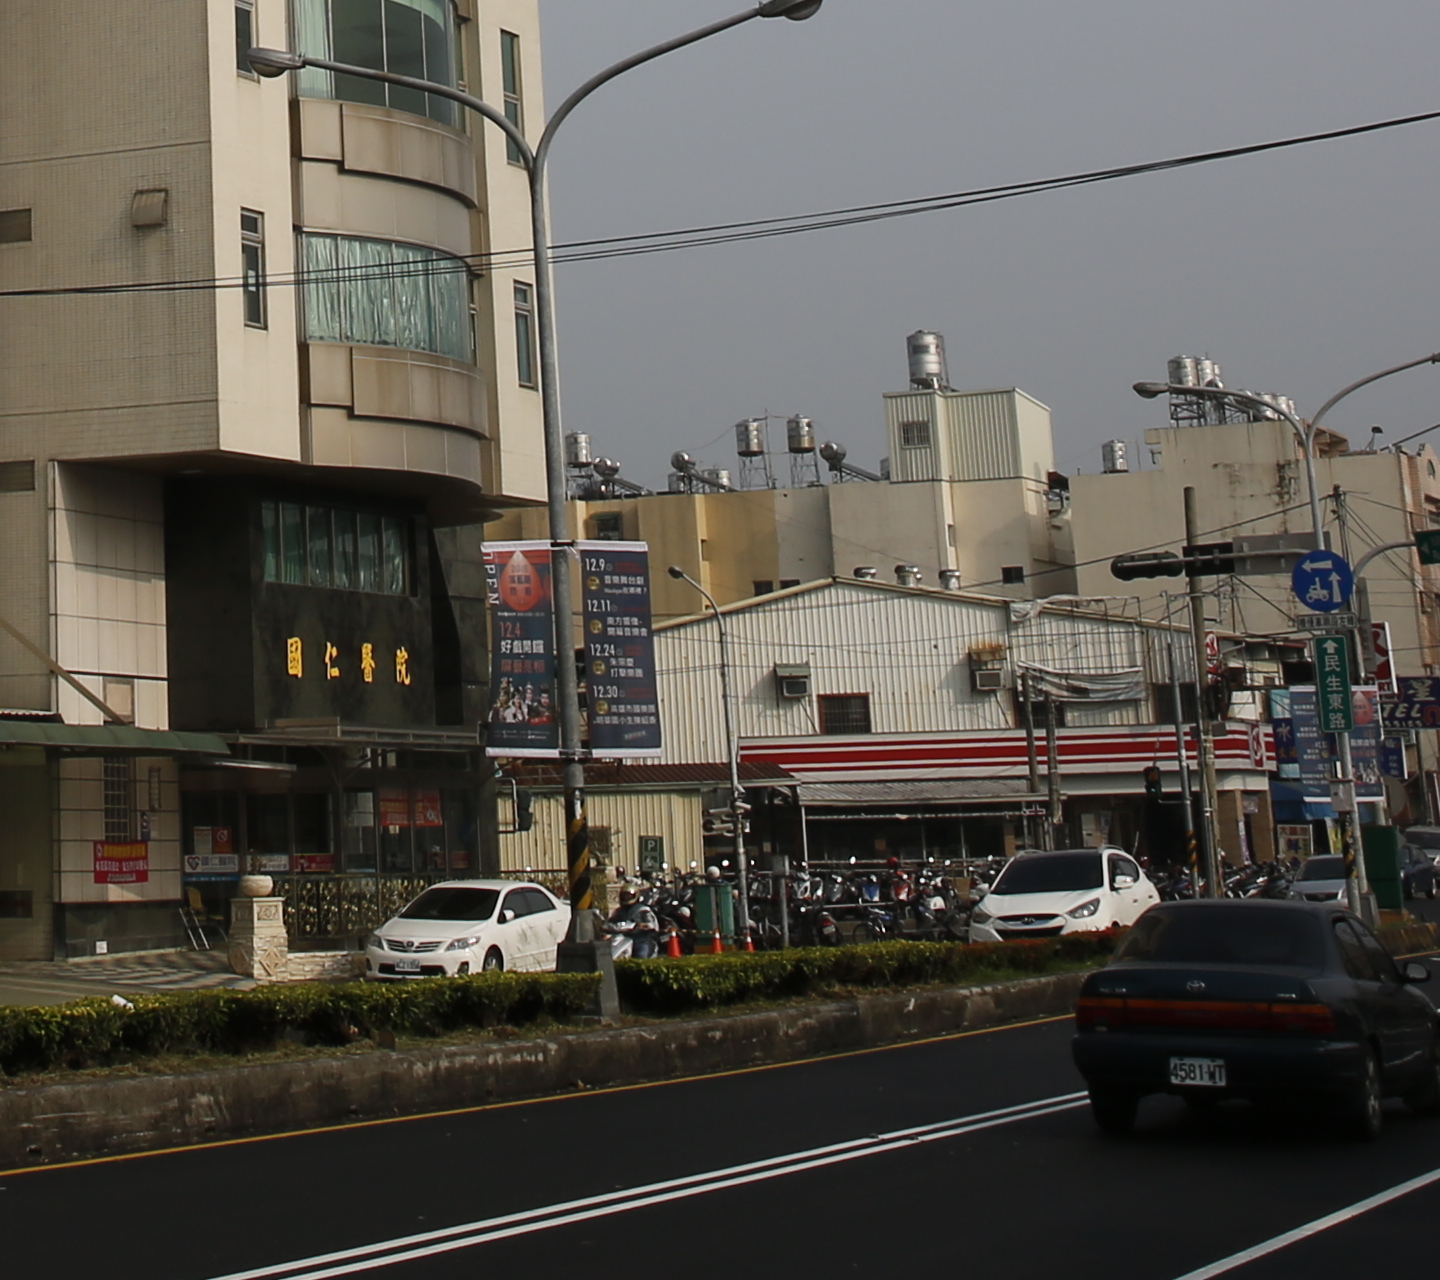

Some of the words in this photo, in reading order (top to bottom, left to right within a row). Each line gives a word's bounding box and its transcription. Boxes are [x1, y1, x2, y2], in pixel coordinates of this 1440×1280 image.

[585, 558, 606, 571] 12.9
[587, 599, 611, 612] 12.11
[590, 643, 615, 656] 12.24
[286, 636, 411, 688] 國仁醫院
[593, 685, 618, 698] 12.30
[1324, 654, 1346, 729] 民生東路
[1382, 703, 1422, 718] TEL
[1170, 1062, 1225, 1083] 4581-WT
